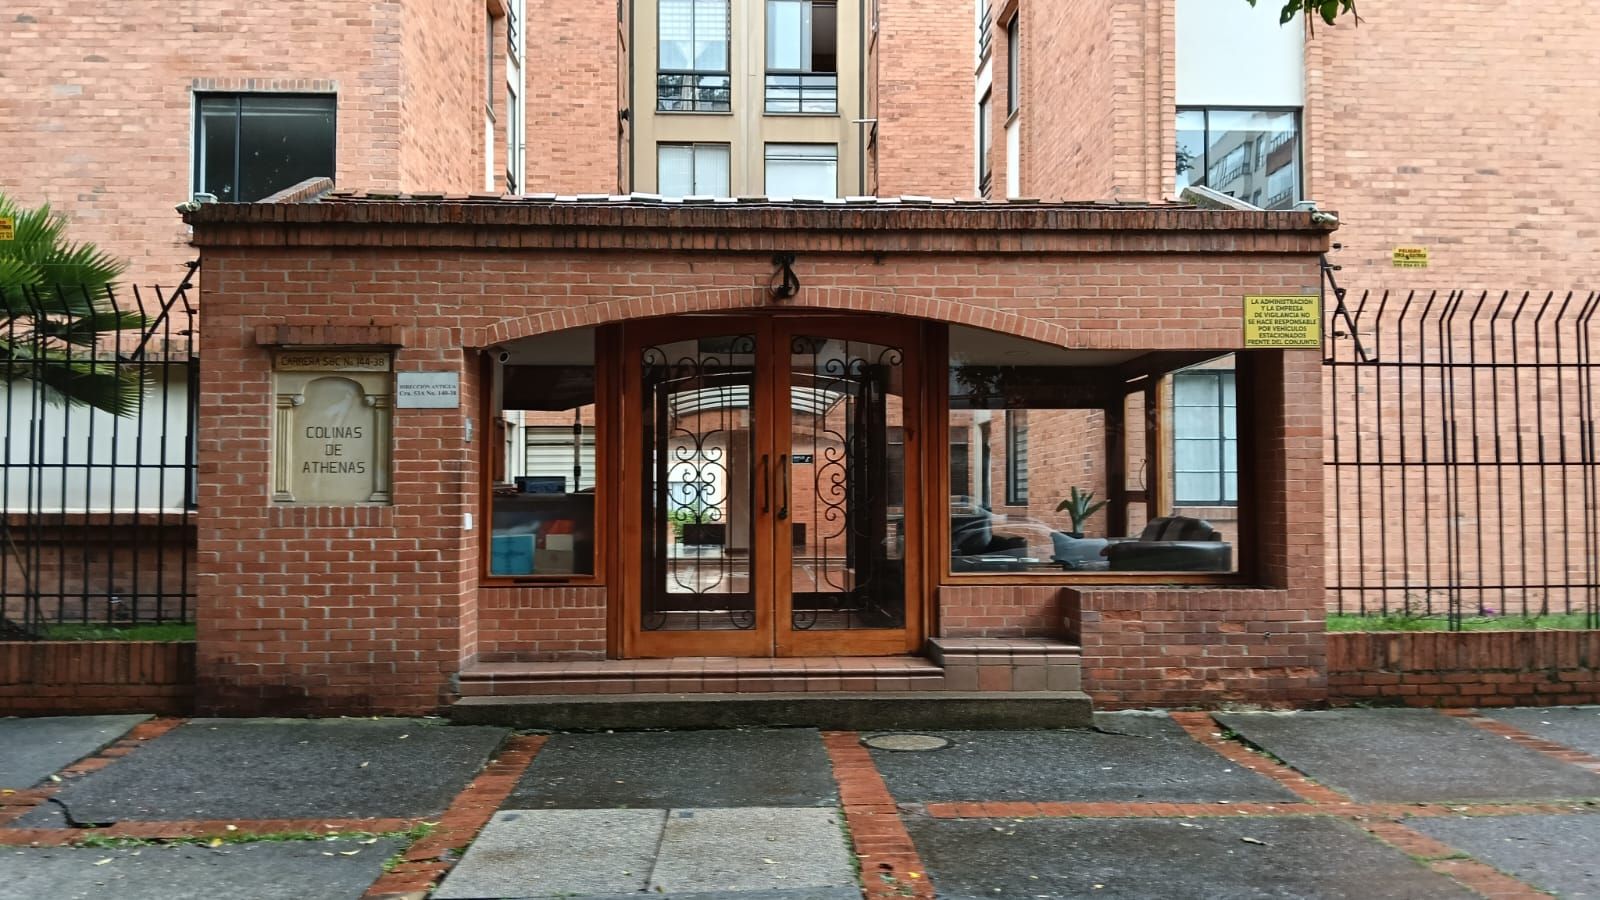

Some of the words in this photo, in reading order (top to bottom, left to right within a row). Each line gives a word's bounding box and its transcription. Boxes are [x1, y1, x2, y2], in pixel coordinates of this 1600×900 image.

[281, 356, 320, 366] CARRERA
[357, 356, 384, 366] 144-38
[306, 426, 362, 438] COLINAS
[325, 444, 343, 456] DE
[302, 461, 365, 473] ATHENAS
